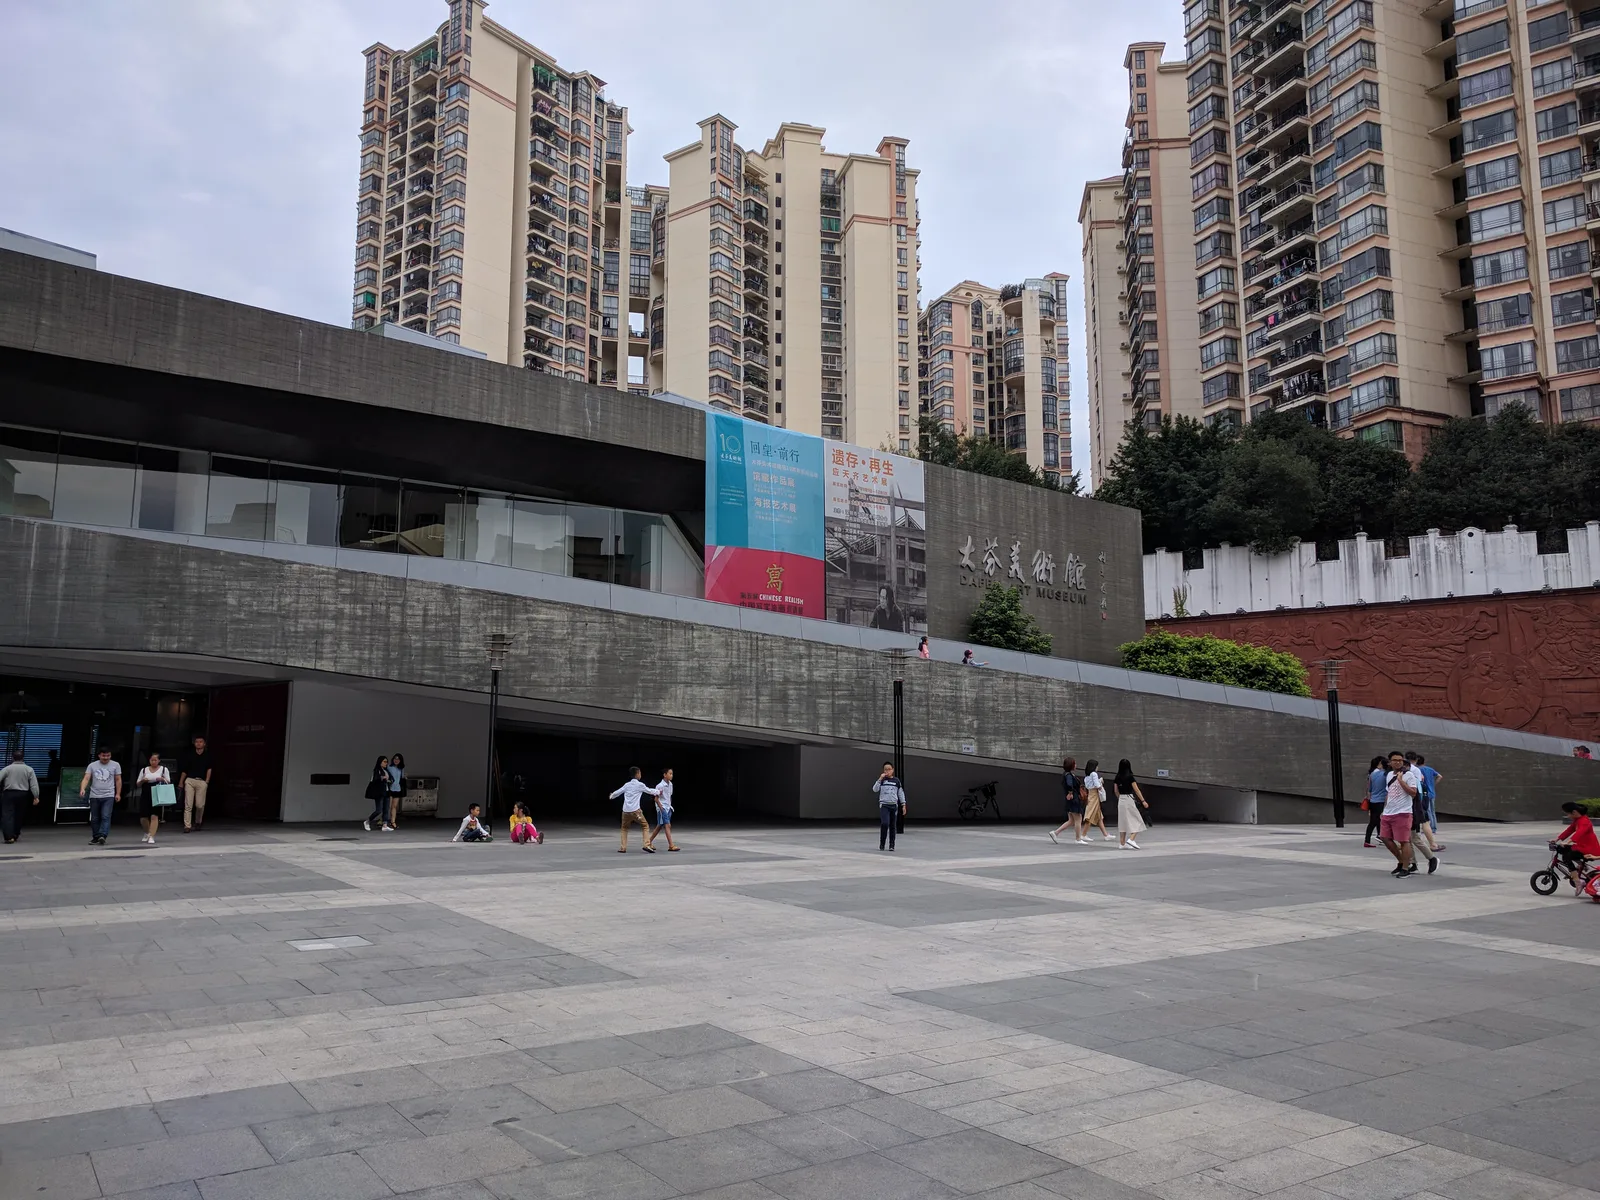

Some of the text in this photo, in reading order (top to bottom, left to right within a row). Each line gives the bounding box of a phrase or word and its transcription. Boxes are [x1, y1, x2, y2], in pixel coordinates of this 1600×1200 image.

[759, 593, 783, 603] CHINESE
[784, 595, 805, 606] REALISM
[959, 574, 993, 590] DAFE
[1036, 586, 1088, 605] MUSEUM
